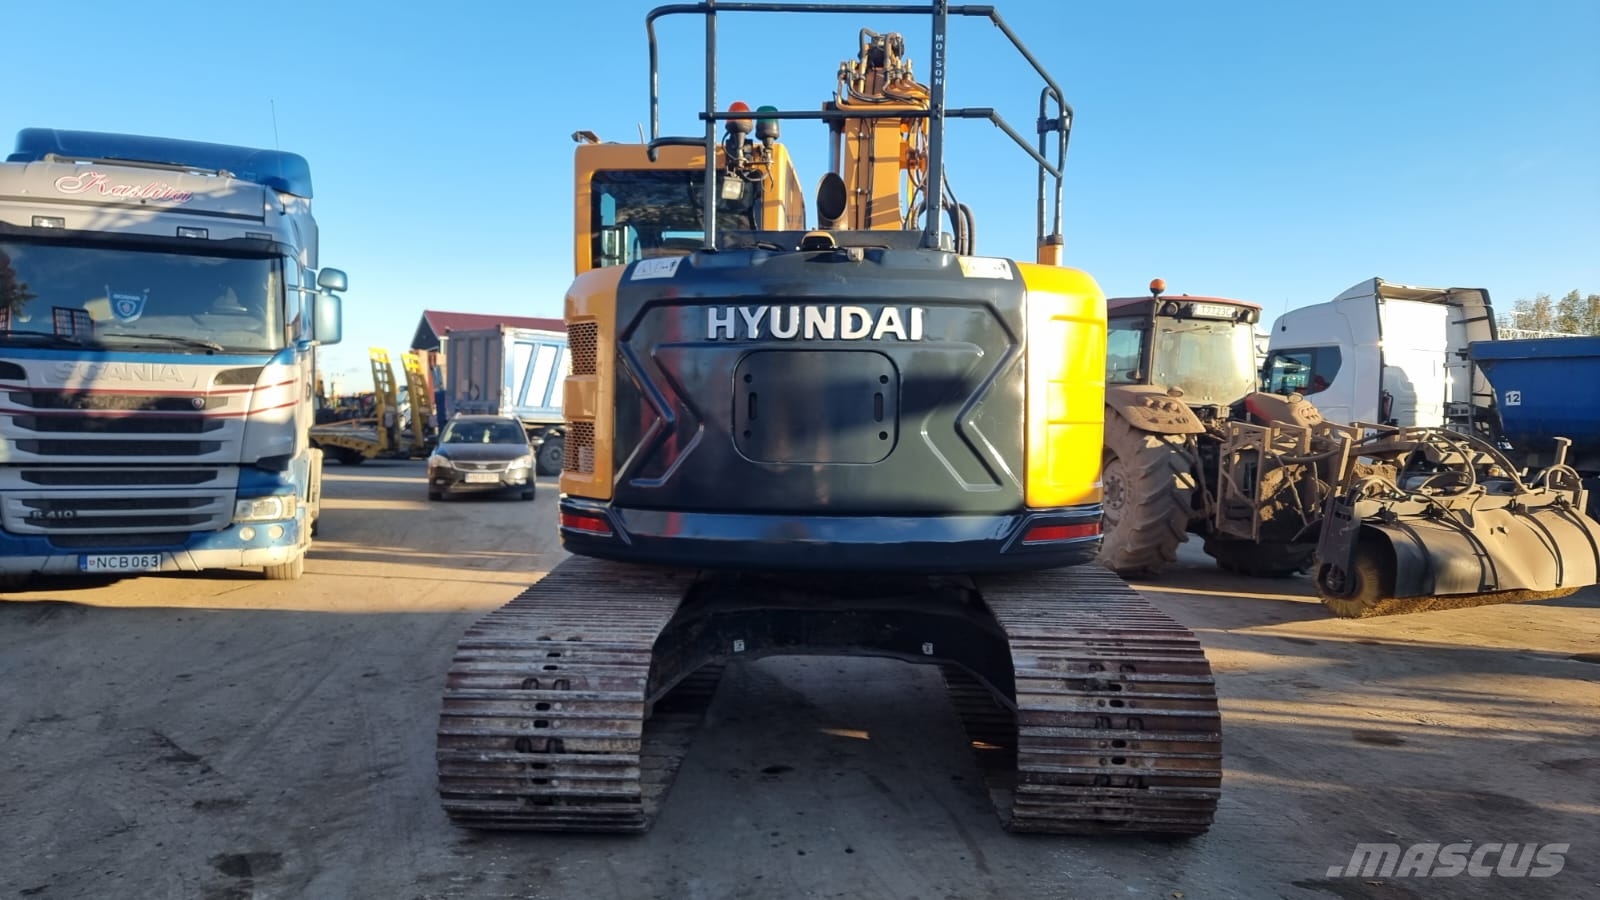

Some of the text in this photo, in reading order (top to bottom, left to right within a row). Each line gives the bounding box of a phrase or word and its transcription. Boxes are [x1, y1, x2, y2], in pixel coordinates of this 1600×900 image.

[935, 34, 944, 85] MOLSON
[708, 305, 923, 341] HYUNDAI
[56, 362, 184, 382] SCANIA
[1506, 393, 1520, 403] 12
